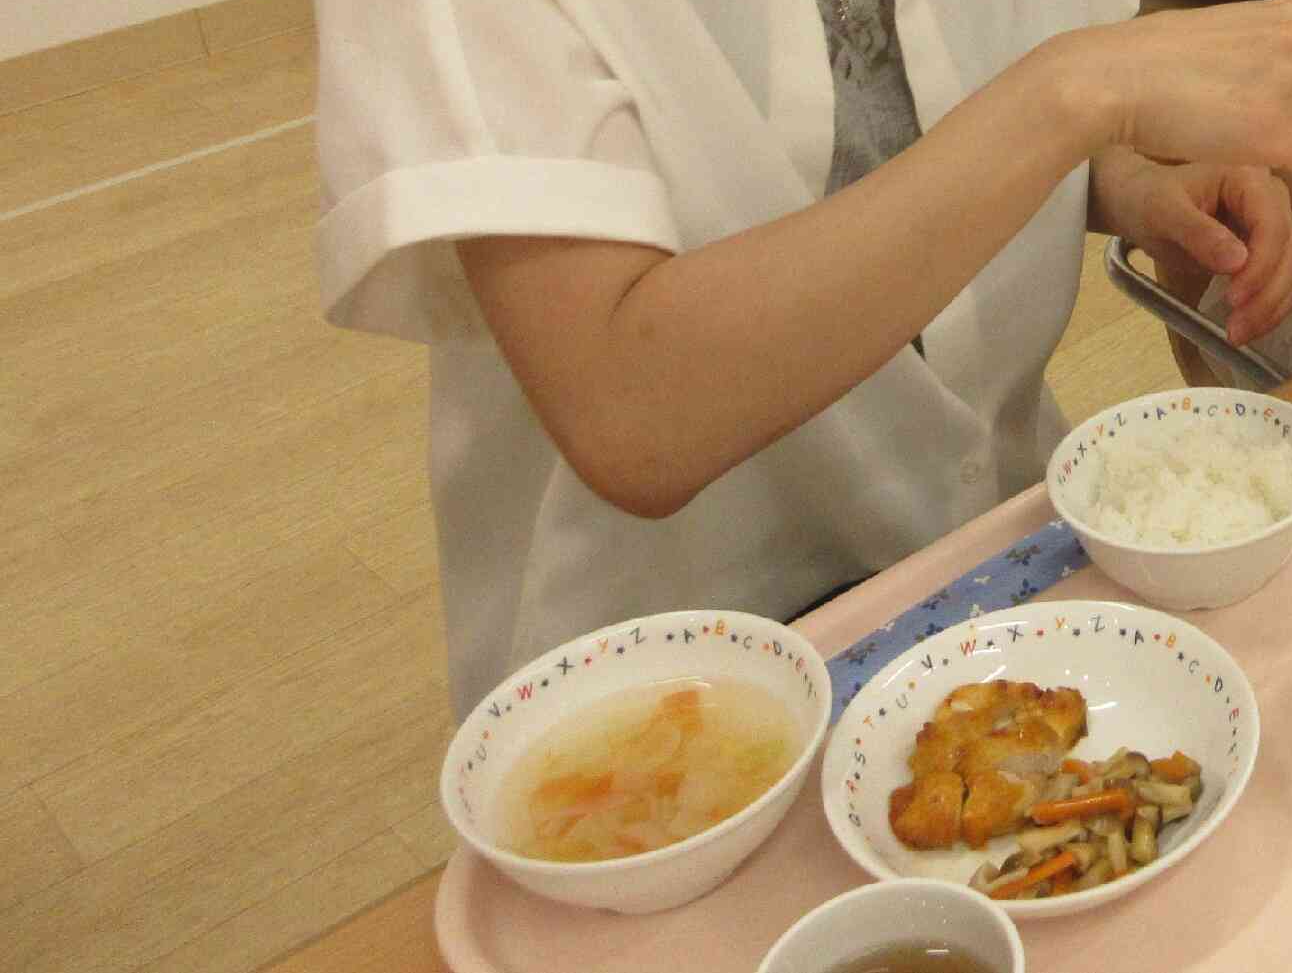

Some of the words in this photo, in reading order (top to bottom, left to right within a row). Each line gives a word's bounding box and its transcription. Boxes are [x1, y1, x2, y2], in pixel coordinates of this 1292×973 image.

[1155, 406, 1168, 421] A
[1182, 396, 1192, 411] B
[1235, 402, 1246, 417] D
[960, 639, 977, 657] W
[1007, 625, 1024, 643] X
[1134, 630, 1145, 646] A
[516, 682, 534, 701] W
[555, 656, 576, 676] X
[629, 626, 647, 645] Z
[714, 620, 725, 636] B
[772, 639, 783, 657] D
